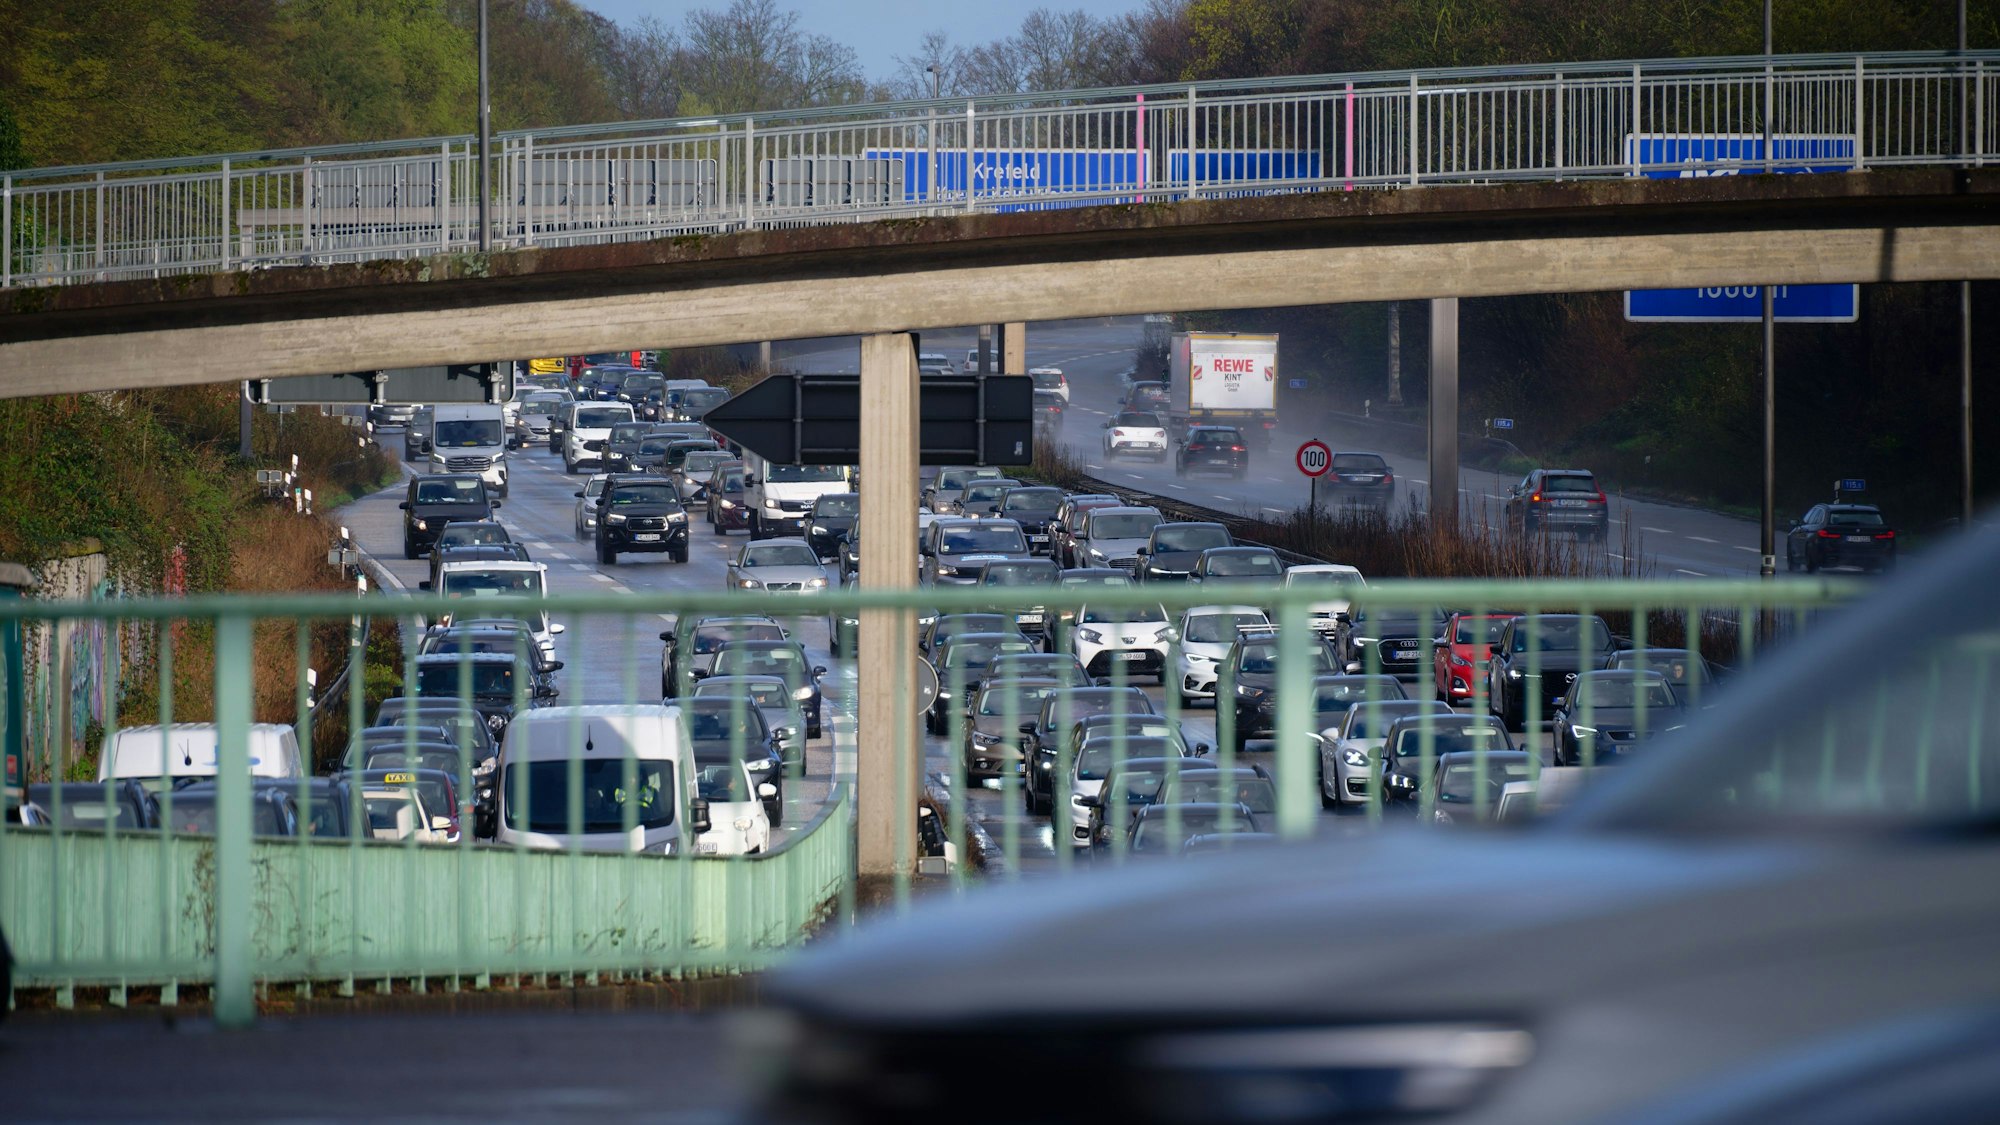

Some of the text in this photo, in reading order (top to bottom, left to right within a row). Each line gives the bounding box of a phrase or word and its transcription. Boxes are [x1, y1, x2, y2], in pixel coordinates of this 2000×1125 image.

[973, 162, 1041, 180] Krefeld
[1213, 359, 1254, 373] REWE
[1224, 373, 1242, 381] KINT
[1303, 450, 1326, 467] 100
[389, 773, 410, 781] TAXI
